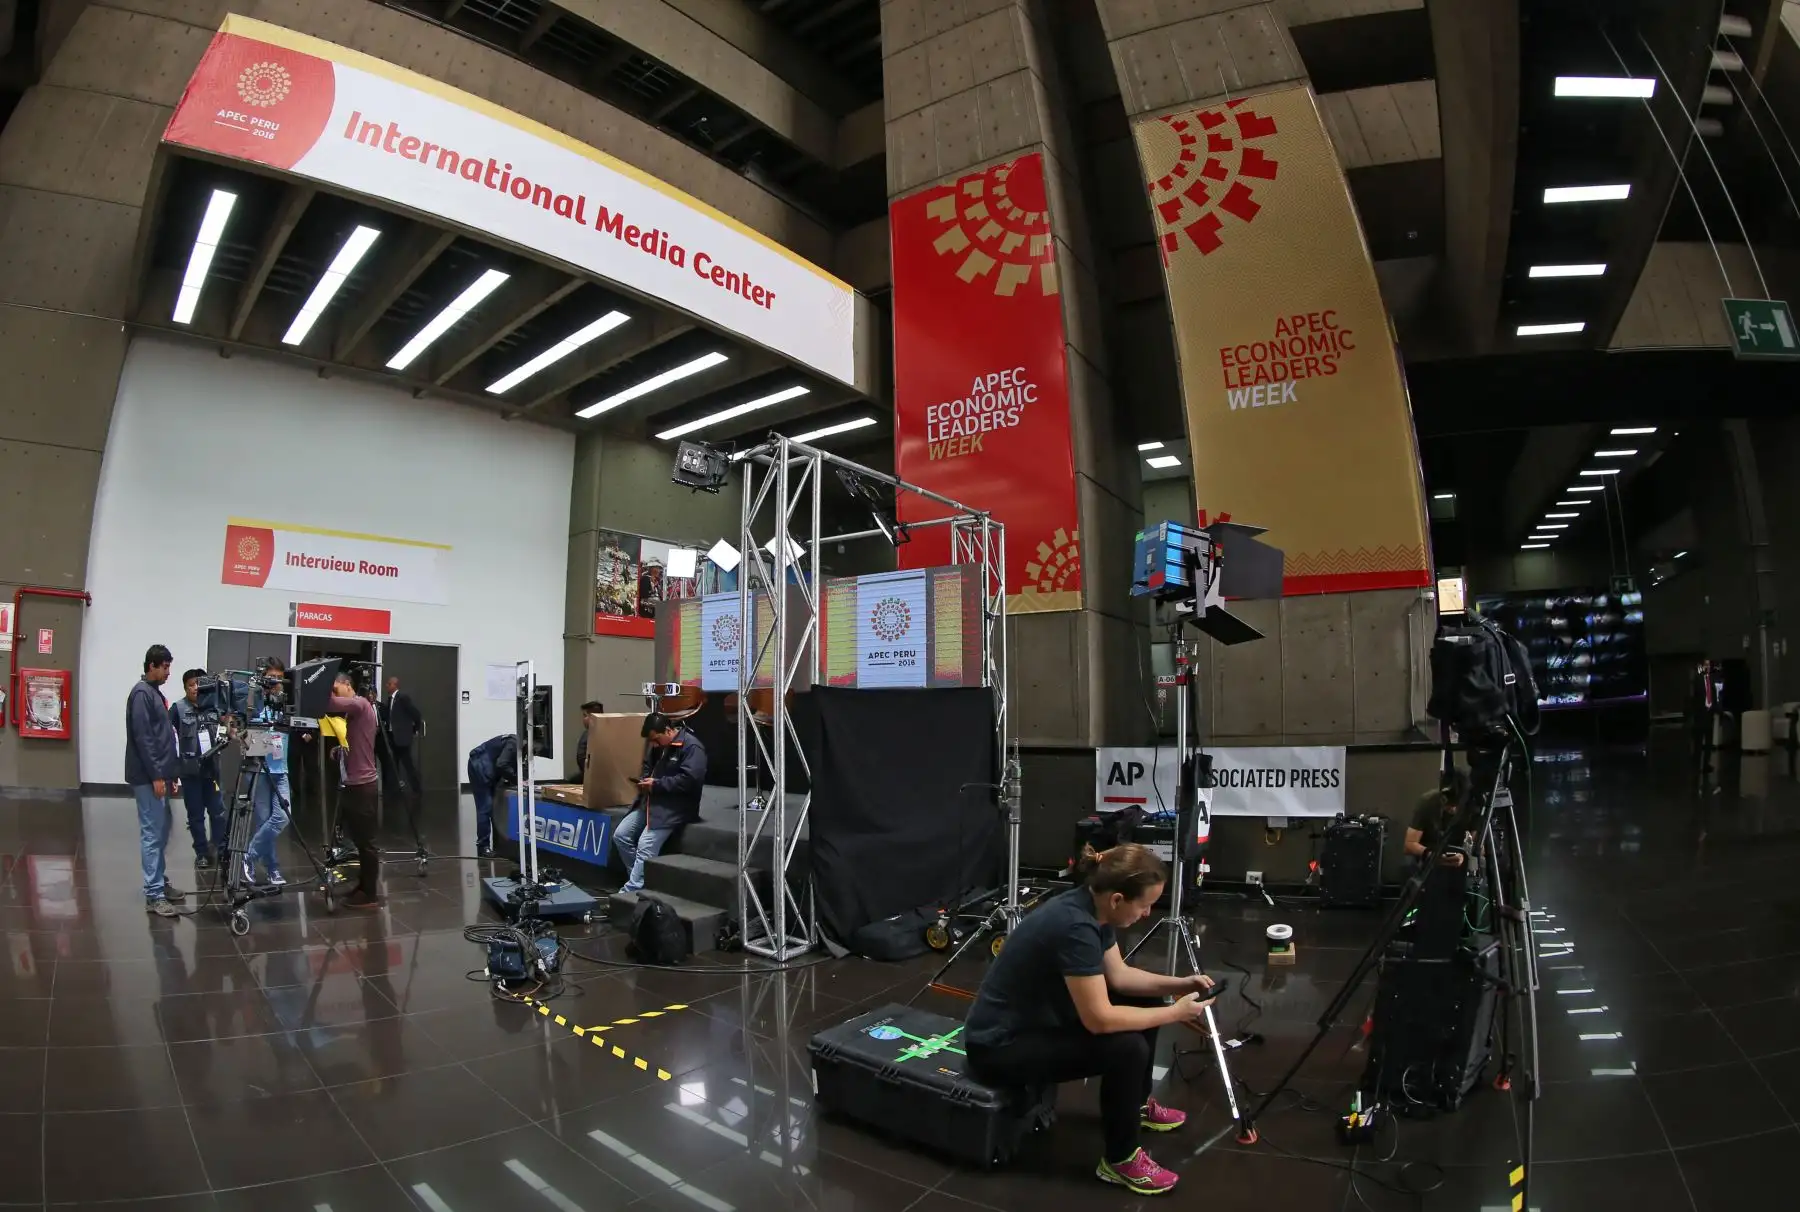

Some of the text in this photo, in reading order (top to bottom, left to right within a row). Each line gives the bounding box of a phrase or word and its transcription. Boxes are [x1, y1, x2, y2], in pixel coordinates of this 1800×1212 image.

[217, 109, 279, 131] APEC PERU
[252, 129, 275, 140] 2016
[344, 111, 776, 309] International Media Center
[1275, 310, 1339, 338] APEC
[1220, 330, 1355, 368] ECONOMIC
[971, 366, 1026, 395] APEC
[1223, 352, 1341, 389] LEADERS'
[927, 384, 1038, 424] ECONOMIC
[1227, 380, 1298, 411] WEEK
[928, 404, 1025, 443] LEADERS'
[928, 433, 984, 461] WEEK
[286, 551, 399, 578] Interview Room
[299, 611, 333, 622] PARACAS
[709, 658, 740, 667] APEC PER
[868, 650, 916, 660] APEC PERU
[898, 659, 916, 667] 2016
[1106, 761, 1145, 786] AP
[1211, 768, 1340, 788] SOCIATED PRESS
[582, 819, 605, 856] N
